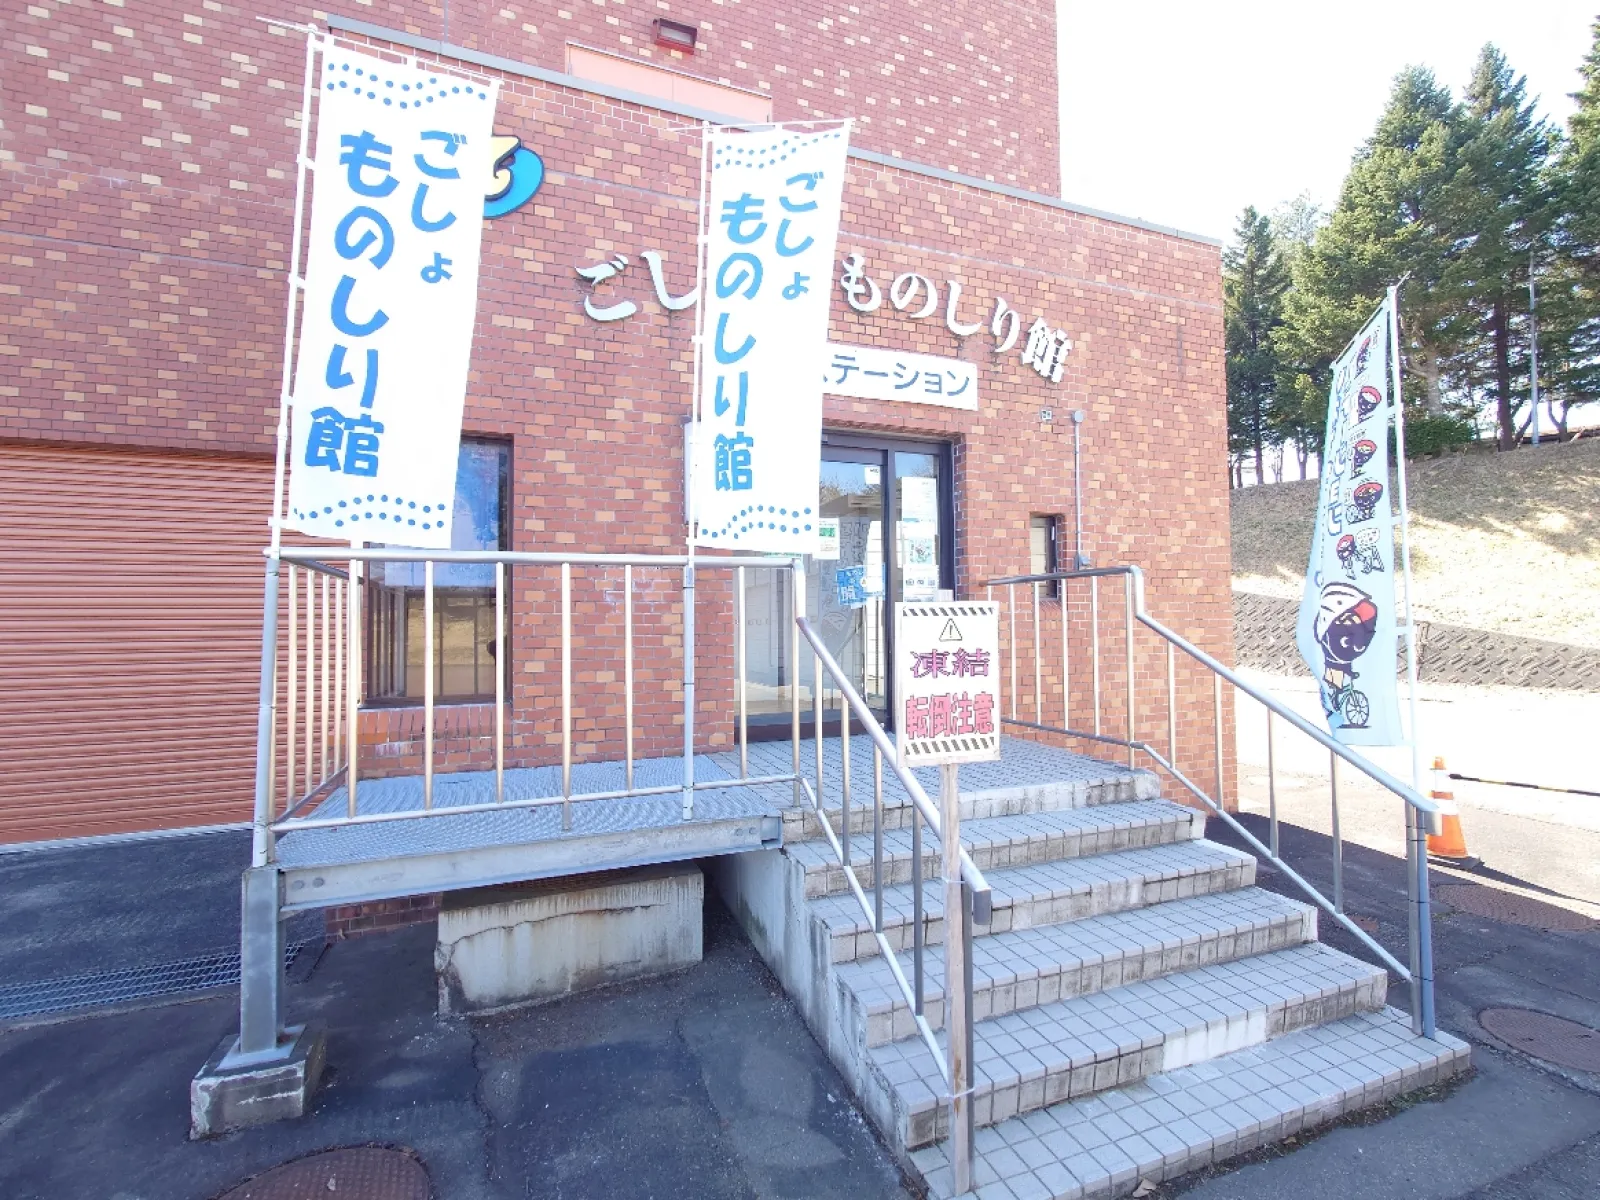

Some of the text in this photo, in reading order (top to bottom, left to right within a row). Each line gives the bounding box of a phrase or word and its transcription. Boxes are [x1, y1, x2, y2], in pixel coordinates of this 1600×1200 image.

[411, 131, 466, 283] ごしょ
[776, 172, 823, 300] ごしょ
[304, 131, 399, 477] ものしり館
[574, 250, 1072, 383] ごし ものしり館
[714, 193, 767, 491] ものしり館
[823, 354, 969, 396] テーション
[905, 691, 995, 740] 転倒注意
[910, 648, 991, 679] 凍結
